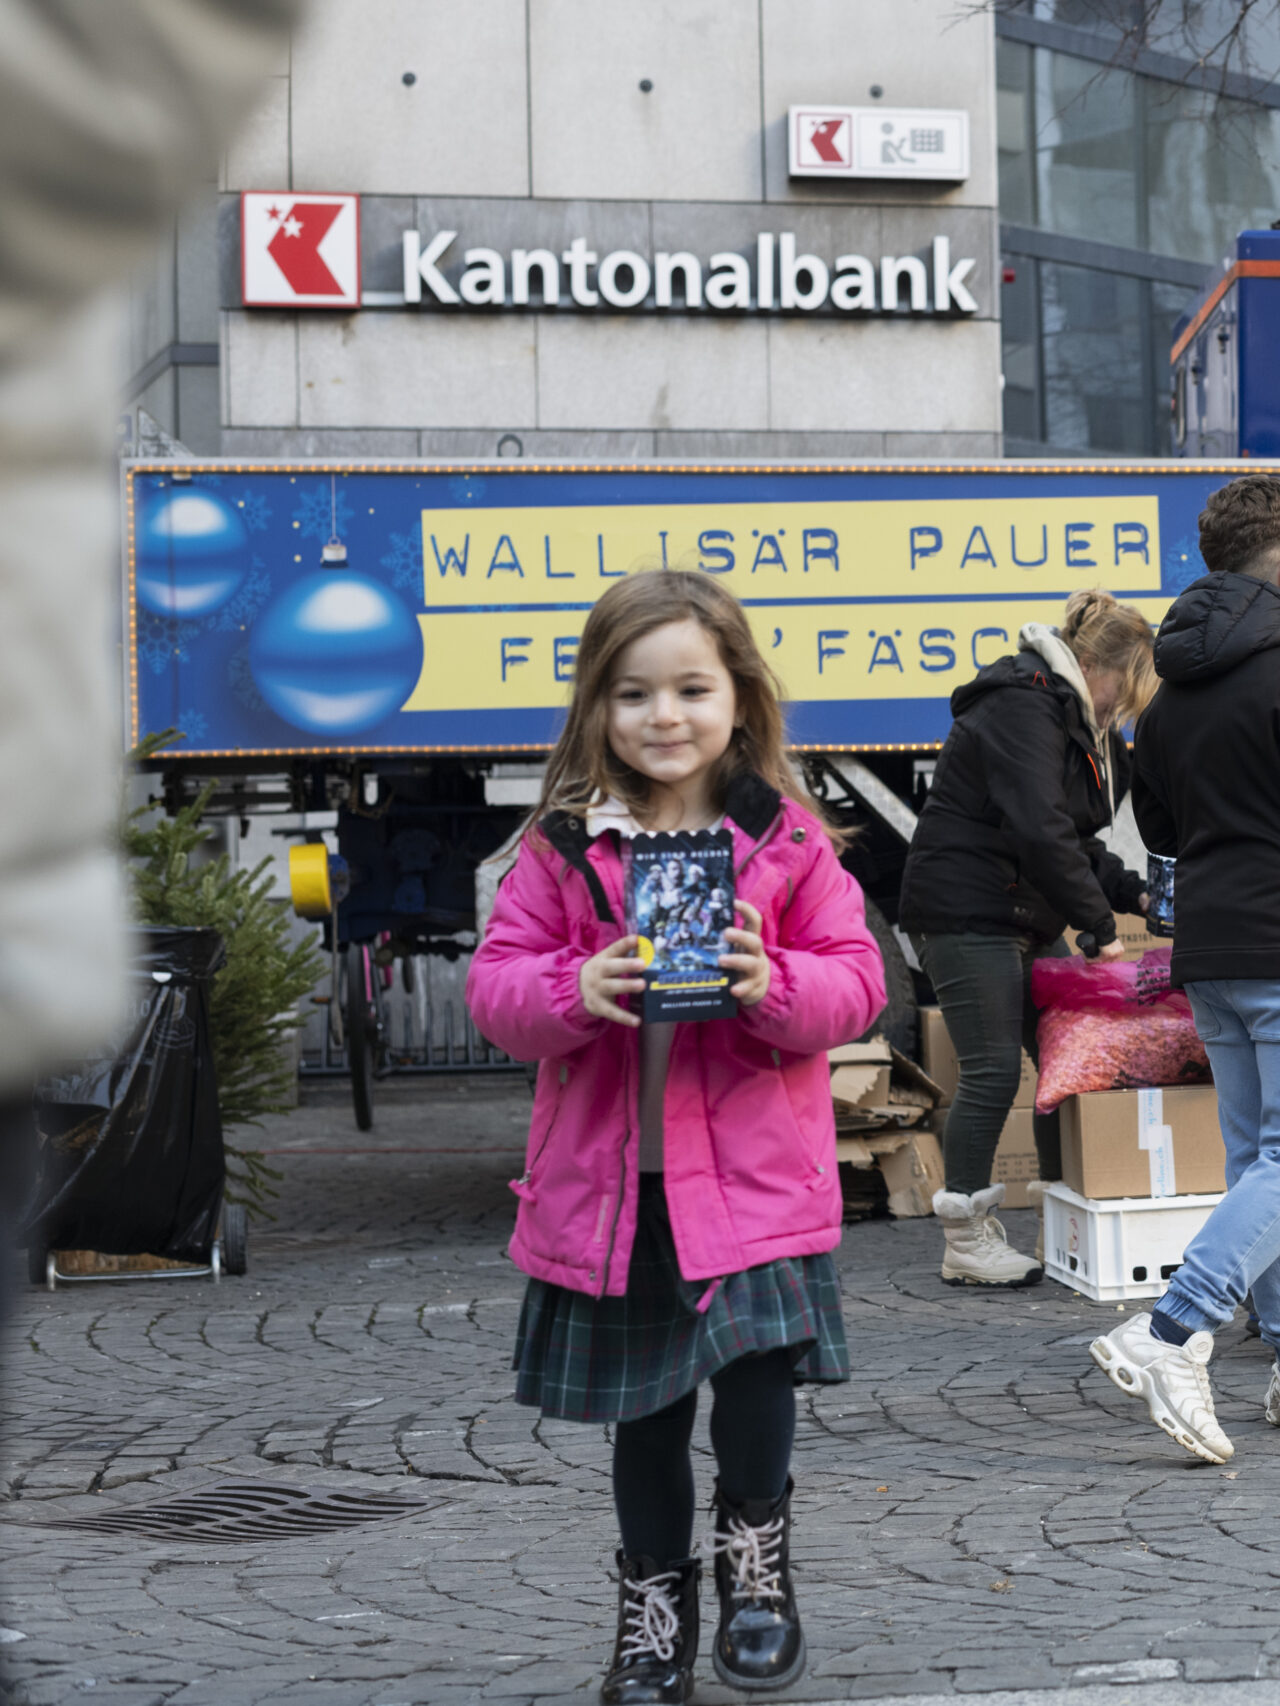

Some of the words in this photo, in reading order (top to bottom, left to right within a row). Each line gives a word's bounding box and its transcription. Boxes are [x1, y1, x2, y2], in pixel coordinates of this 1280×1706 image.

[403, 229, 979, 312] Kantonalbank
[909, 521, 1150, 571] PAUER
[500, 636, 581, 683] FE
